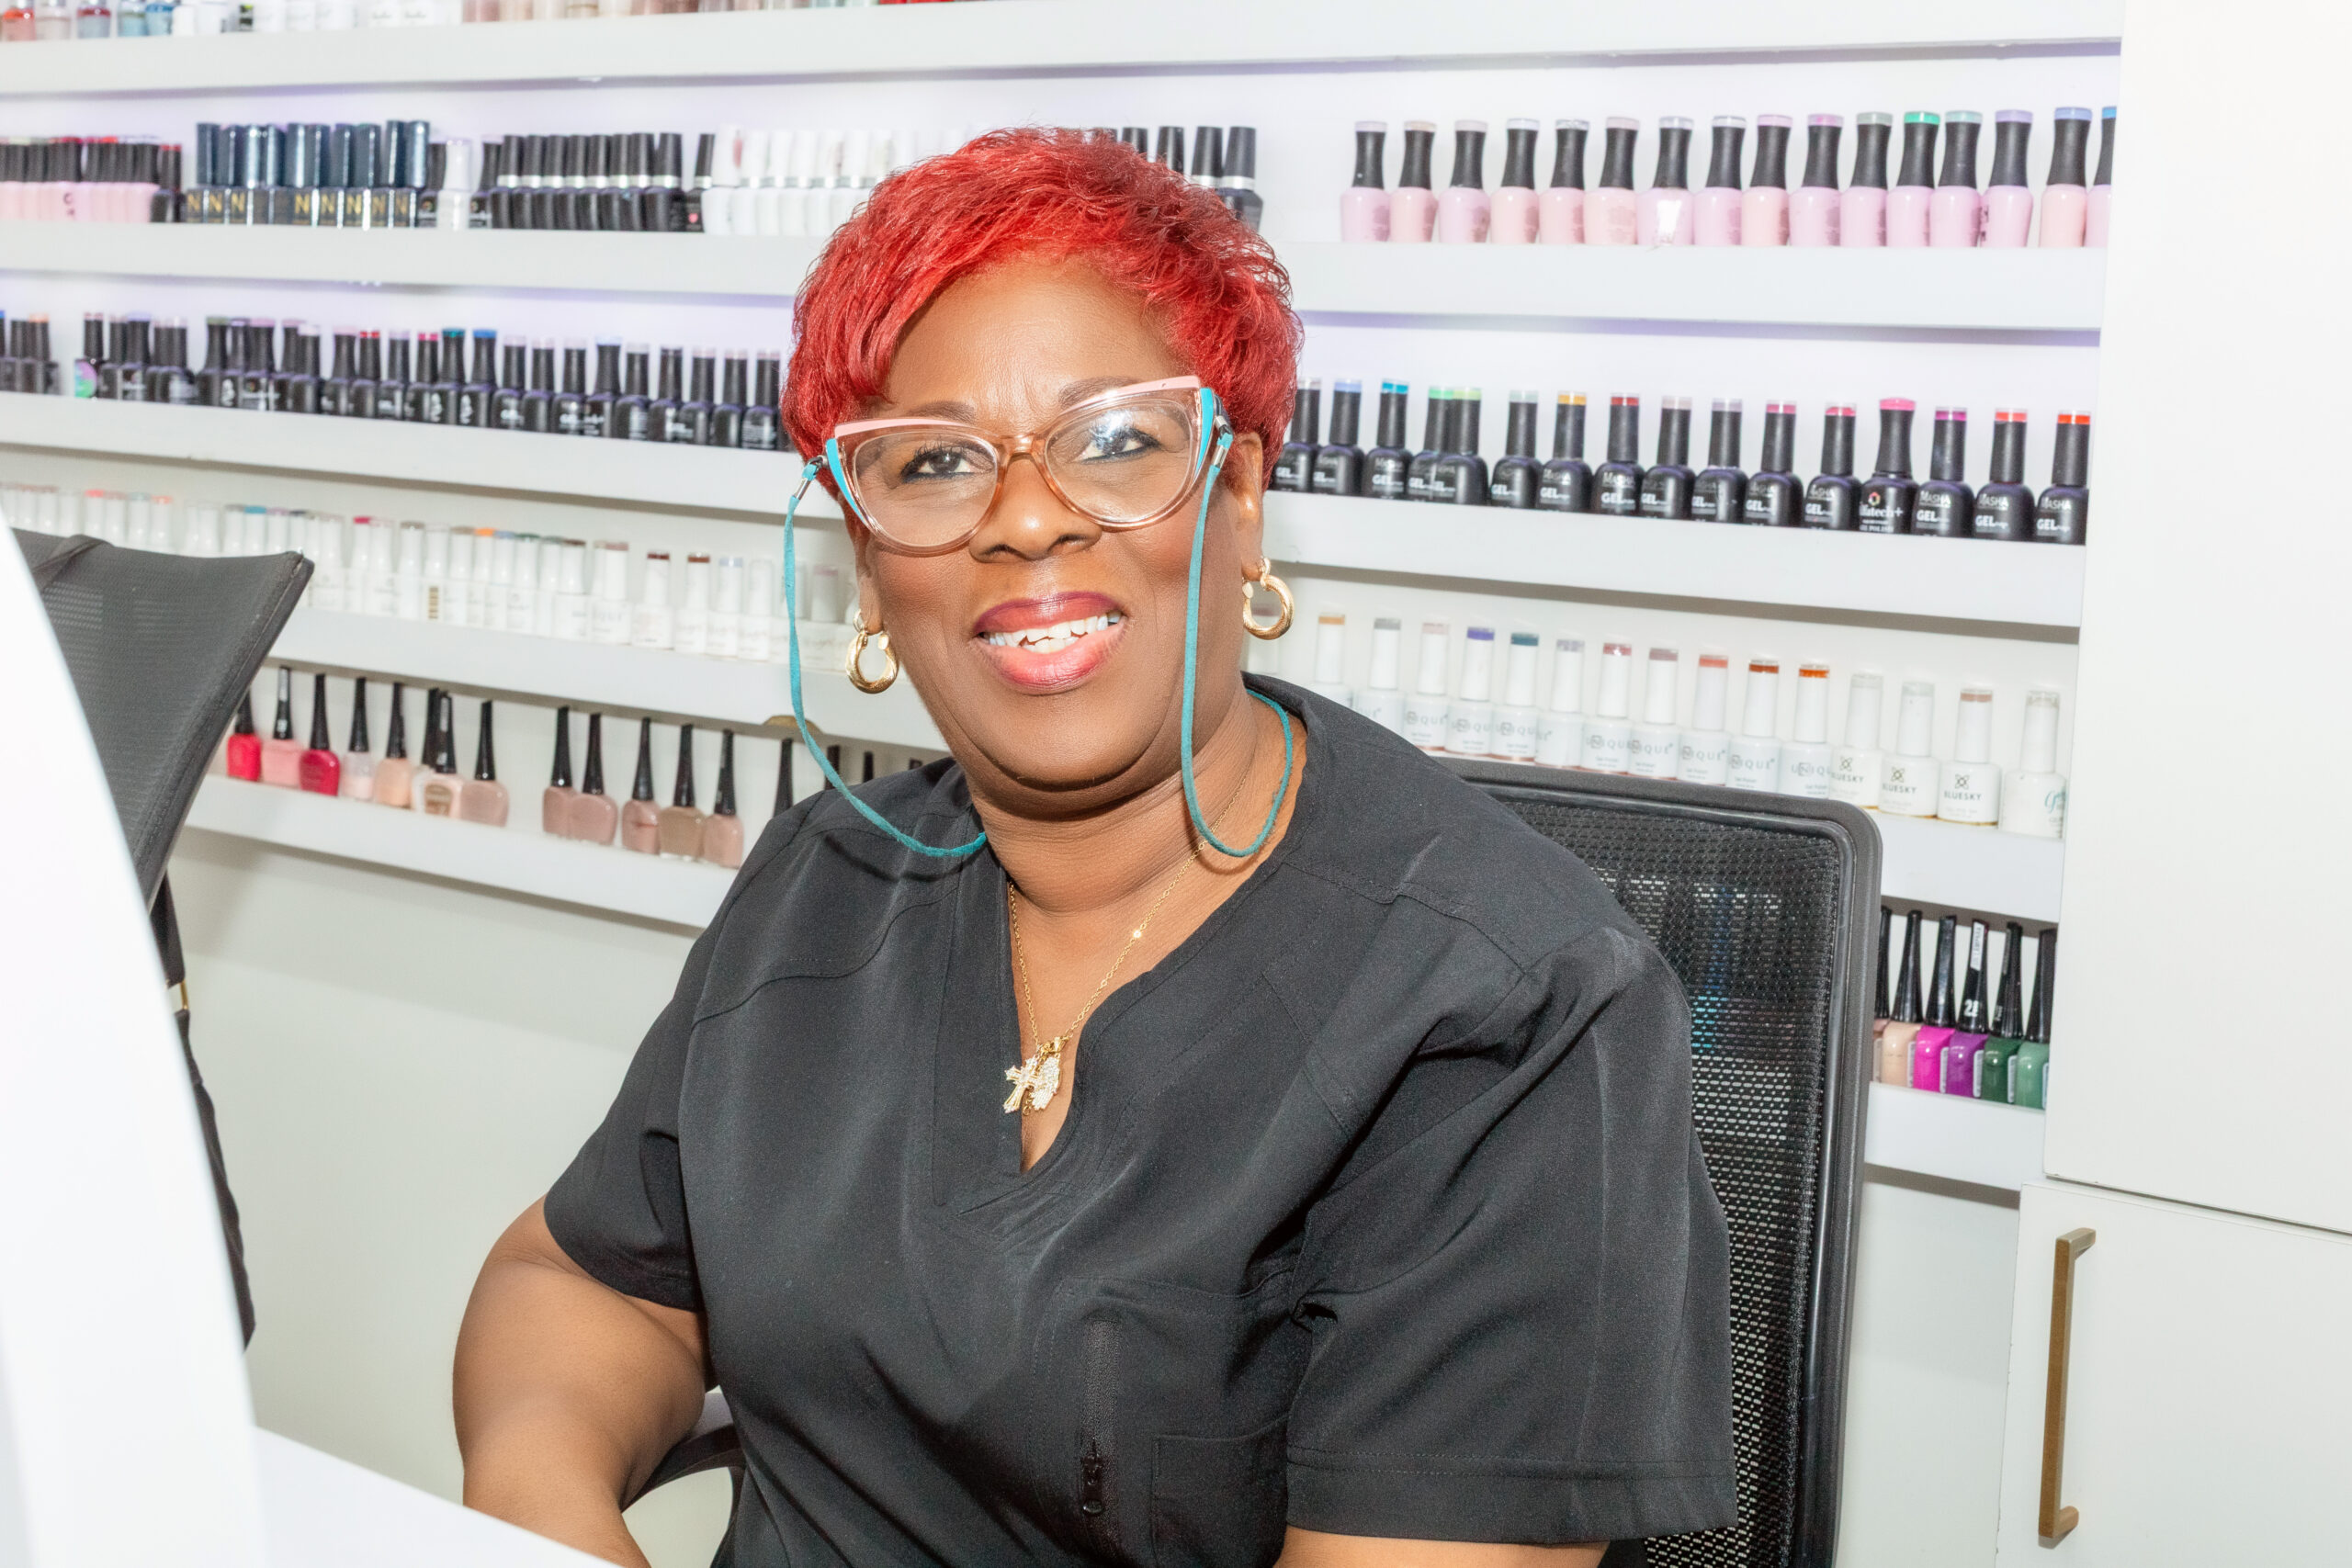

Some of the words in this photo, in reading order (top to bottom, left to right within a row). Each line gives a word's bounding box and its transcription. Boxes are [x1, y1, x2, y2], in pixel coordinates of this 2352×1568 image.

[209, 194, 222, 213] N
[232, 193, 245, 212] N
[295, 194, 310, 213] N
[321, 194, 335, 213] N
[346, 194, 361, 214] N
[372, 194, 386, 214] N
[1541, 488, 1558, 499] GEL
[1601, 492, 1623, 503] GEL
[1920, 491, 1951, 505] MASHA
[1805, 503, 1823, 514] GEL
[1917, 511, 1937, 522] GEL
[1975, 515, 1995, 526] GEL
[2037, 519, 2057, 530] GEL
[1944, 791, 1982, 801] BLUESKY
